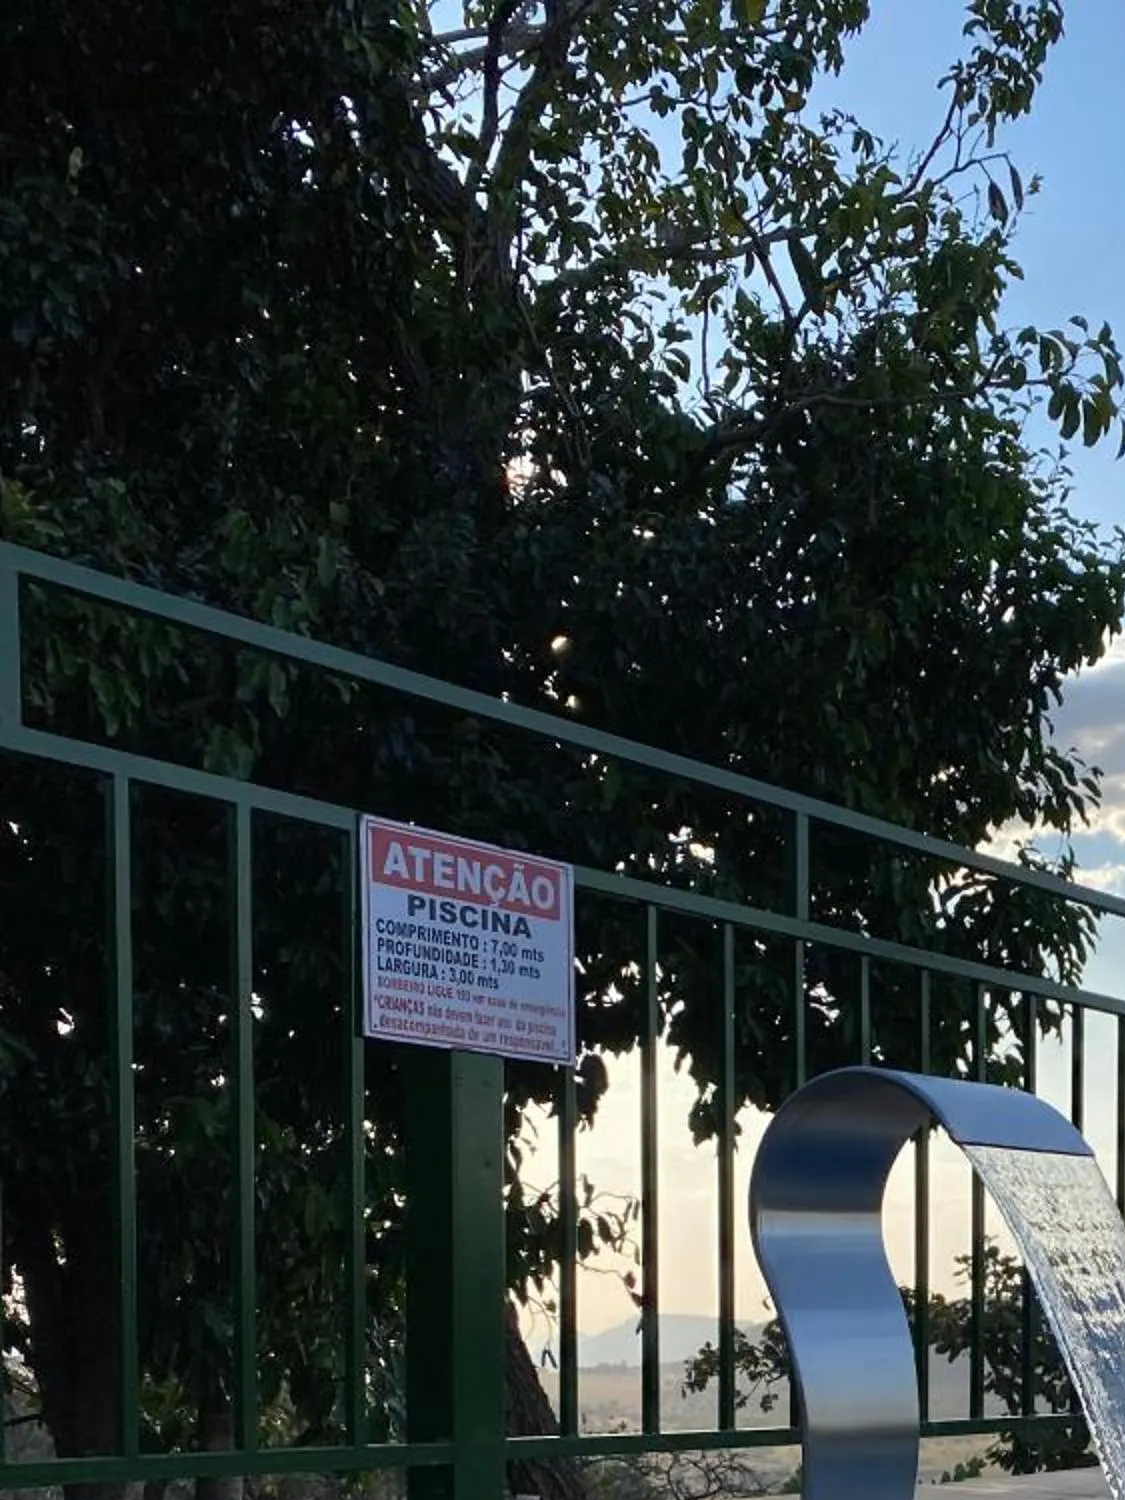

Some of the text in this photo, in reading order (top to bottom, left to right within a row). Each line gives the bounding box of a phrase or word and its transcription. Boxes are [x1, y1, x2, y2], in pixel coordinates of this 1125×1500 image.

[383, 840, 556, 911] ATENÇÃO
[407, 893, 532, 939] PISCINA
[376, 917, 479, 951] COMPRIMENTO
[491, 938, 518, 958] 7,00
[521, 948, 545, 963] mts
[377, 937, 479, 969] PROFUNDIDADE
[519, 964, 541, 979] mts
[377, 955, 439, 981] LARGURA
[449, 966, 476, 986] 3,00
[477, 974, 499, 990] mts
